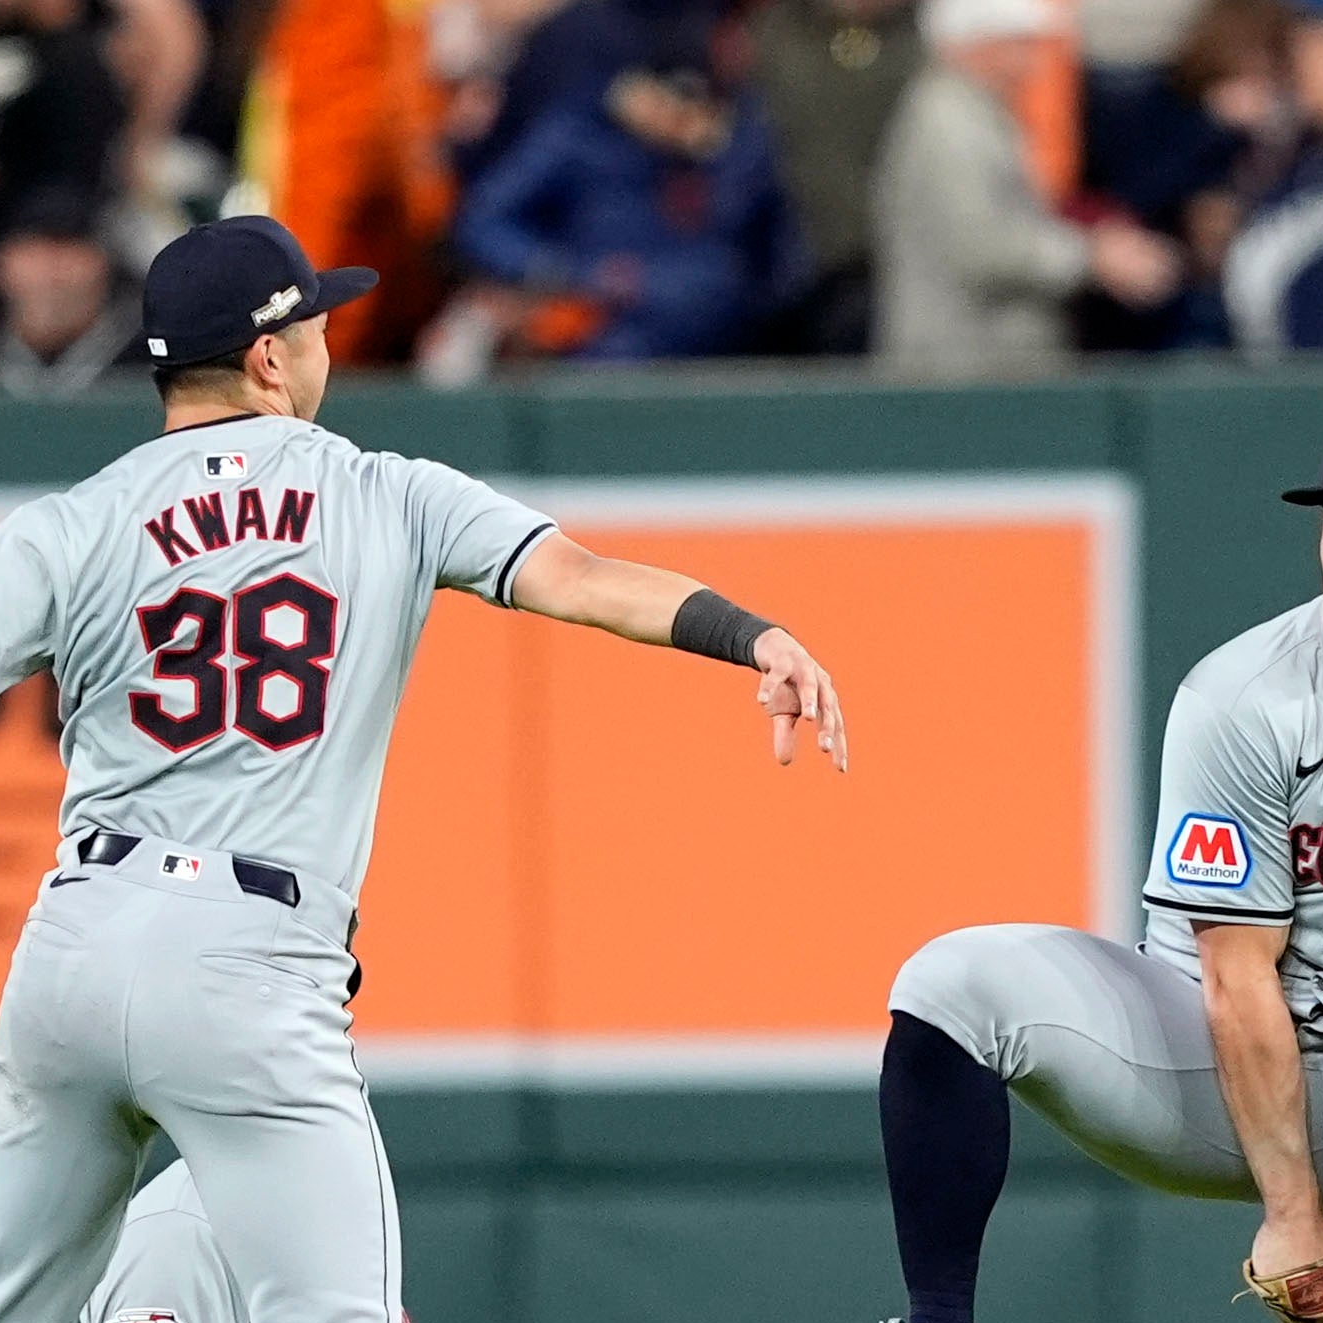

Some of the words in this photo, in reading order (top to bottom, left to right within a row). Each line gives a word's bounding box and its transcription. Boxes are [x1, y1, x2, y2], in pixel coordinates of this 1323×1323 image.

[144, 488, 315, 567] KWAN
[127, 572, 338, 753] 38
[1176, 863, 1239, 879] Marathon
